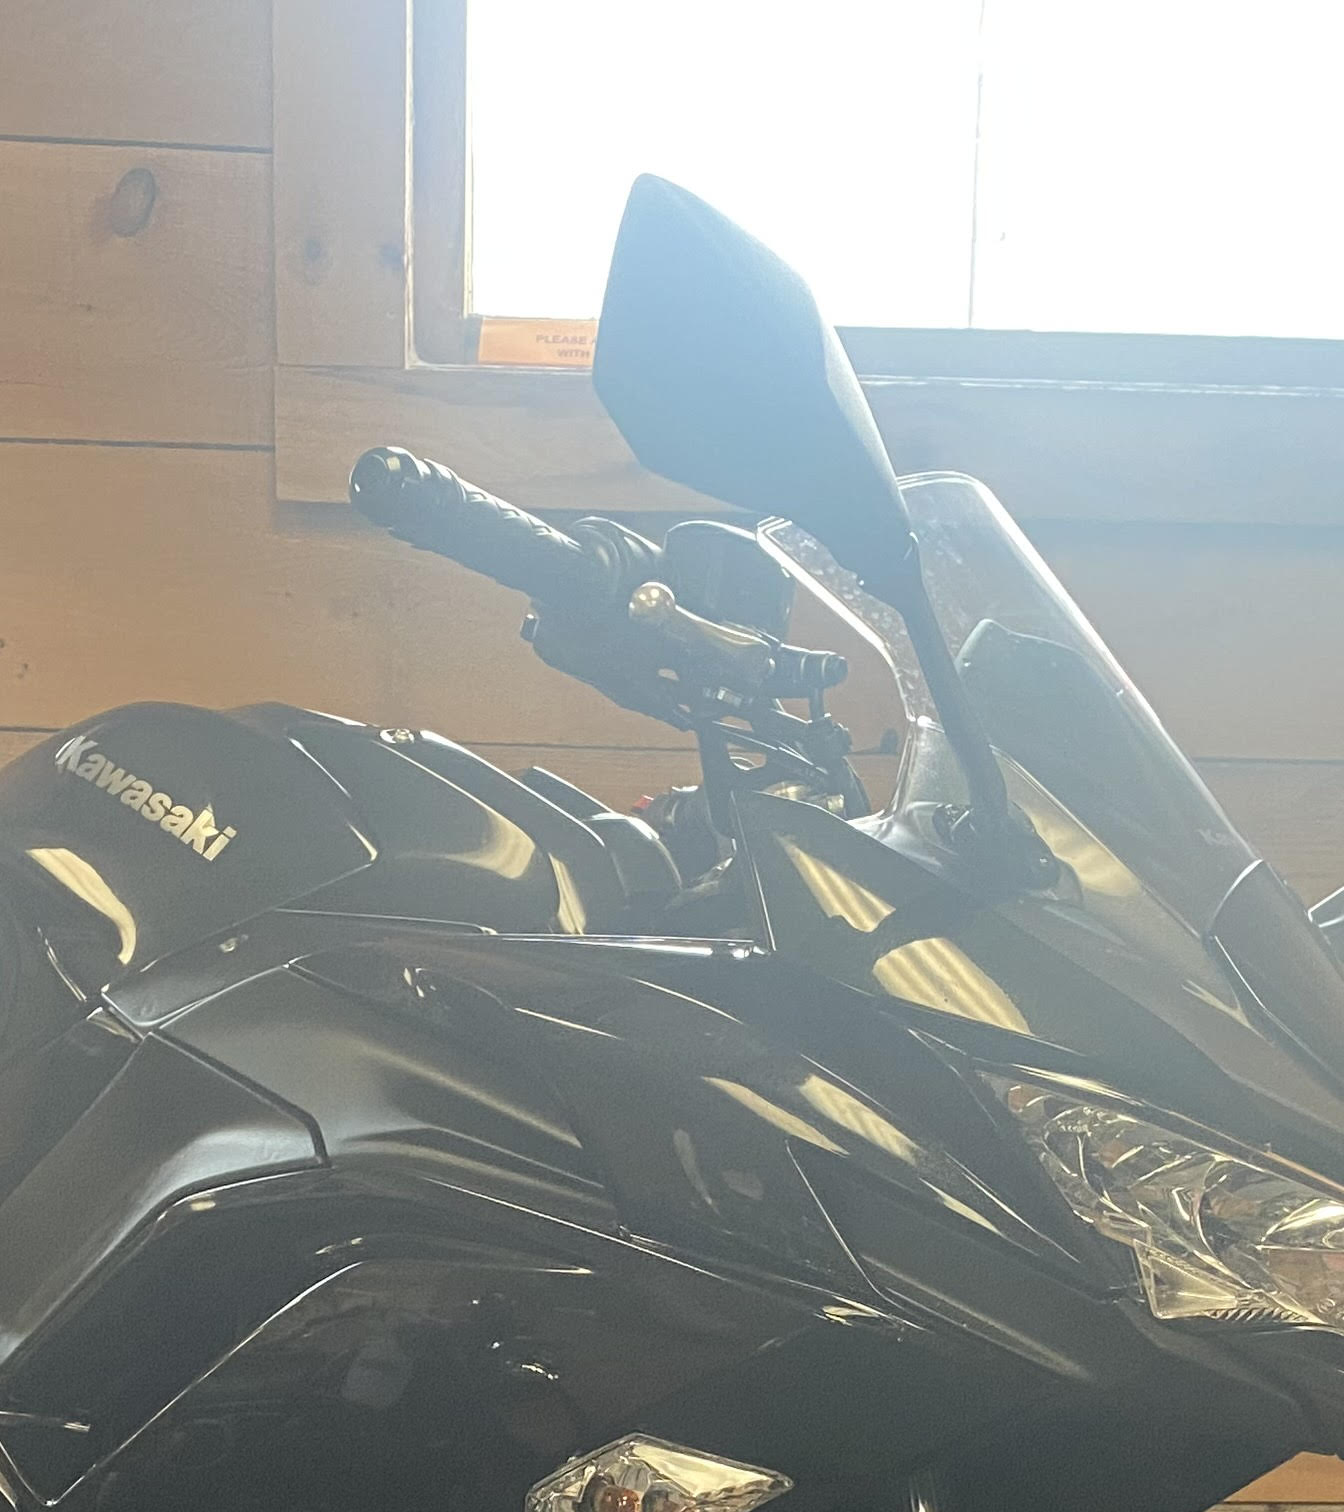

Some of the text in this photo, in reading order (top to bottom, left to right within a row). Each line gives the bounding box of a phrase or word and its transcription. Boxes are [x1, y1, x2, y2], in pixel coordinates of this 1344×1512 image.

[536, 335, 587, 344] PLEASE
[557, 349, 590, 358] WITH
[56, 735, 237, 861] Kawasaki
